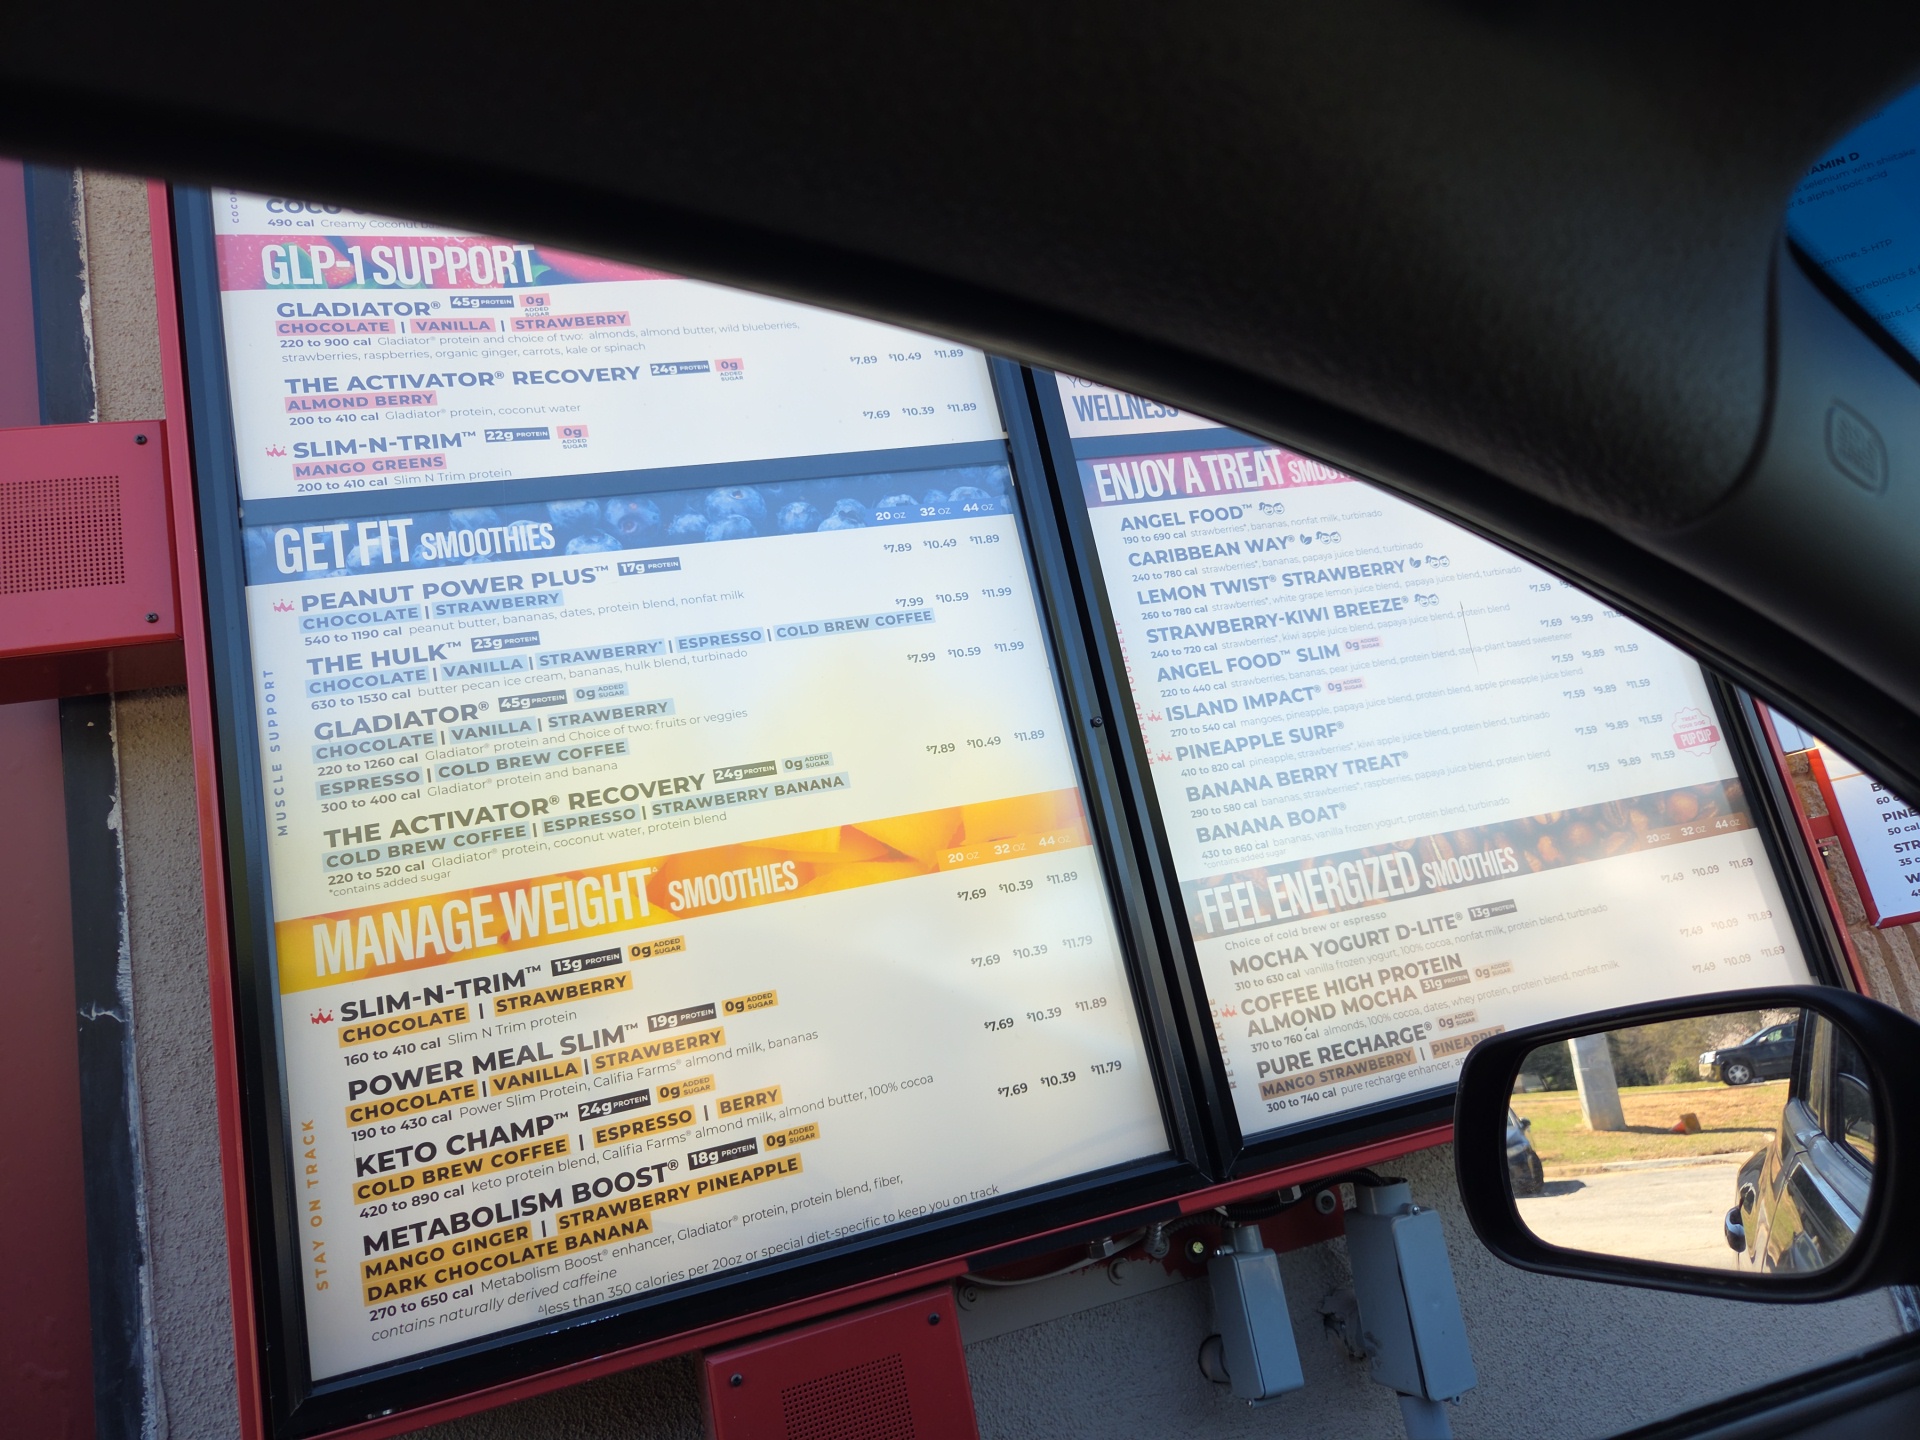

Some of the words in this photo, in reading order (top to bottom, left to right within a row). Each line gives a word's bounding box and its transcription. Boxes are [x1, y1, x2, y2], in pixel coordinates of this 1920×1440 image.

[267, 218, 293, 227] 490
[296, 218, 314, 227] cal
[320, 218, 367, 230] Creamy
[261, 244, 365, 286] GLP-1
[371, 244, 535, 285] SUPPORT
[452, 297, 479, 309] 45g
[481, 298, 512, 306] PROTEIN
[525, 296, 544, 307] 0g
[278, 320, 390, 334] CHOCOLATE
[415, 319, 491, 332] VANILLA
[515, 313, 627, 330] STRAWBERRY
[281, 351, 361, 363] strawberries,
[364, 349, 432, 361] raspberries,
[435, 348, 478, 360] organic
[481, 347, 518, 358] ginger,
[522, 346, 563, 356] carrots,
[566, 345, 588, 354] kale
[591, 345, 602, 354] or
[604, 341, 646, 354] spinach
[850, 354, 878, 365] $7.89
[888, 351, 922, 362] $10.49
[934, 348, 964, 359] $11.89
[285, 376, 339, 394] THE
[512, 365, 641, 386] RECOVERY
[651, 364, 677, 375] 24g
[679, 363, 709, 372] PROTEIN
[721, 359, 739, 371] 0g
[287, 396, 369, 411] ALMOND
[375, 393, 434, 407] BERRY
[296, 462, 366, 478] MANGO
[372, 456, 444, 473] GREENS
[297, 482, 322, 492] 200
[326, 481, 341, 491] to
[344, 479, 366, 490] 410
[369, 476, 388, 487] cal
[394, 474, 421, 485] Slim
[425, 473, 434, 483] N
[437, 471, 465, 482] Trim
[469, 468, 512, 482] protein
[1093, 456, 1177, 502] ENJOY
[1183, 456, 1202, 498] A
[1201, 449, 1284, 493] TREAT
[876, 511, 891, 521] 20
[894, 511, 906, 520] OZ
[920, 507, 936, 517] 32
[938, 507, 951, 515] OZ
[963, 502, 979, 512] 44
[981, 503, 994, 511] OZ
[1121, 511, 1185, 532] ANGEL
[274, 524, 349, 574] GET
[357, 518, 413, 566] FIT
[421, 522, 556, 561] SMOOTHIES
[883, 543, 912, 554] $7.89
[923, 538, 957, 550] $10.49
[970, 534, 1000, 545] $11.89
[1123, 535, 1139, 545] 190
[1153, 533, 1171, 542] 690
[1174, 531, 1187, 539] cal
[1128, 542, 1241, 567] CARIBBEAN
[301, 585, 414, 612] PEANUT
[422, 575, 524, 599] POWER
[621, 562, 645, 574] 17g
[648, 561, 679, 569] PROTEIN
[1137, 584, 1206, 606] LEMON
[1281, 559, 1405, 588] STRAWBERRY
[302, 606, 419, 630] CHOCOLATE
[435, 592, 559, 616] STRAWBERRY
[307, 652, 363, 676] THE
[309, 669, 427, 694] CHOCOLATE
[443, 657, 524, 677] VANILLA
[678, 629, 762, 650] ESPRESSO
[776, 623, 819, 639] COLD
[824, 617, 870, 633] BREW
[875, 610, 933, 627] COFFEE
[264, 670, 281, 752] SUPPORT
[1575, 725, 1597, 735] $7.59
[1605, 720, 1629, 730] $9.89
[1639, 714, 1663, 724] $11.59
[1175, 731, 1285, 762] PINEAPPLE
[1680, 731, 1696, 746] PUP
[1696, 729, 1711, 744] CUP
[272, 763, 288, 837] MUSCLE
[1186, 775, 1273, 803] BANANA
[1276, 763, 1338, 787] BERRY
[1888, 827, 1901, 836] 50
[383, 876, 418, 890] added
[421, 871, 451, 884] sugar
[957, 888, 987, 902] $7.69
[998, 879, 1034, 894] $10.39
[1046, 871, 1078, 885] $11.89
[1197, 885, 1271, 934] FEEL
[1267, 852, 1421, 919] ENERGIZED
[1424, 847, 1519, 889] SMOOTHIES
[312, 894, 499, 978] MANAGE
[668, 860, 799, 912] SMOOTHIES
[1224, 938, 1261, 952] Choice
[1264, 935, 1274, 943] of
[1277, 929, 1299, 942] cold
[1302, 924, 1327, 936] brew
[1330, 922, 1340, 930] or
[1342, 911, 1387, 929] espresso
[971, 954, 1000, 968] $7.69
[1013, 944, 1048, 959] $10.39
[1062, 935, 1093, 949] $11.79
[1230, 946, 1308, 976] MOCHA
[1310, 928, 1390, 958] YOGURT
[1240, 985, 1320, 1016] COFFEE
[1324, 972, 1375, 998] HIGH
[1378, 953, 1463, 985] PROTEIN
[1247, 1006, 1336, 1038] ALMOND
[1342, 989, 1418, 1016] MOCHA
[348, 1060, 463, 1100] POWER
[472, 1042, 552, 1074] MEAL
[1256, 1051, 1314, 1078] PURE
[1262, 1075, 1316, 1098] MANGO
[1319, 1051, 1412, 1083] STRAWBERRY
[1266, 1101, 1286, 1113] 300
[1288, 1099, 1298, 1108] to
[1301, 1092, 1320, 1105] 740
[1322, 1088, 1337, 1098] cal
[301, 1120, 320, 1189] TRACK
[355, 1142, 437, 1177] KETO
[309, 1199, 323, 1228] ON
[363, 1188, 563, 1256] METABOLISM
[691, 1151, 719, 1166] 18g
[722, 1143, 756, 1158] PROTEIN
[364, 1248, 445, 1279] MANGO
[452, 1226, 529, 1257] GINGER
[558, 1185, 690, 1230] STRAWBERRY
[697, 1158, 798, 1195] PINEAPPLE
[313, 1241, 328, 1291] STAY
[367, 1272, 428, 1301] DARK
[434, 1242, 559, 1284] CHOCOLATE
[564, 1218, 649, 1251] BANANA
[369, 1306, 397, 1322] 270
[400, 1302, 416, 1313] to
[420, 1292, 448, 1309] 650
[452, 1285, 474, 1299] cal
[371, 1315, 436, 1342] contains
[438, 1298, 504, 1327] naturally
[507, 1283, 560, 1306] derived
[562, 1267, 618, 1293] caffeine
